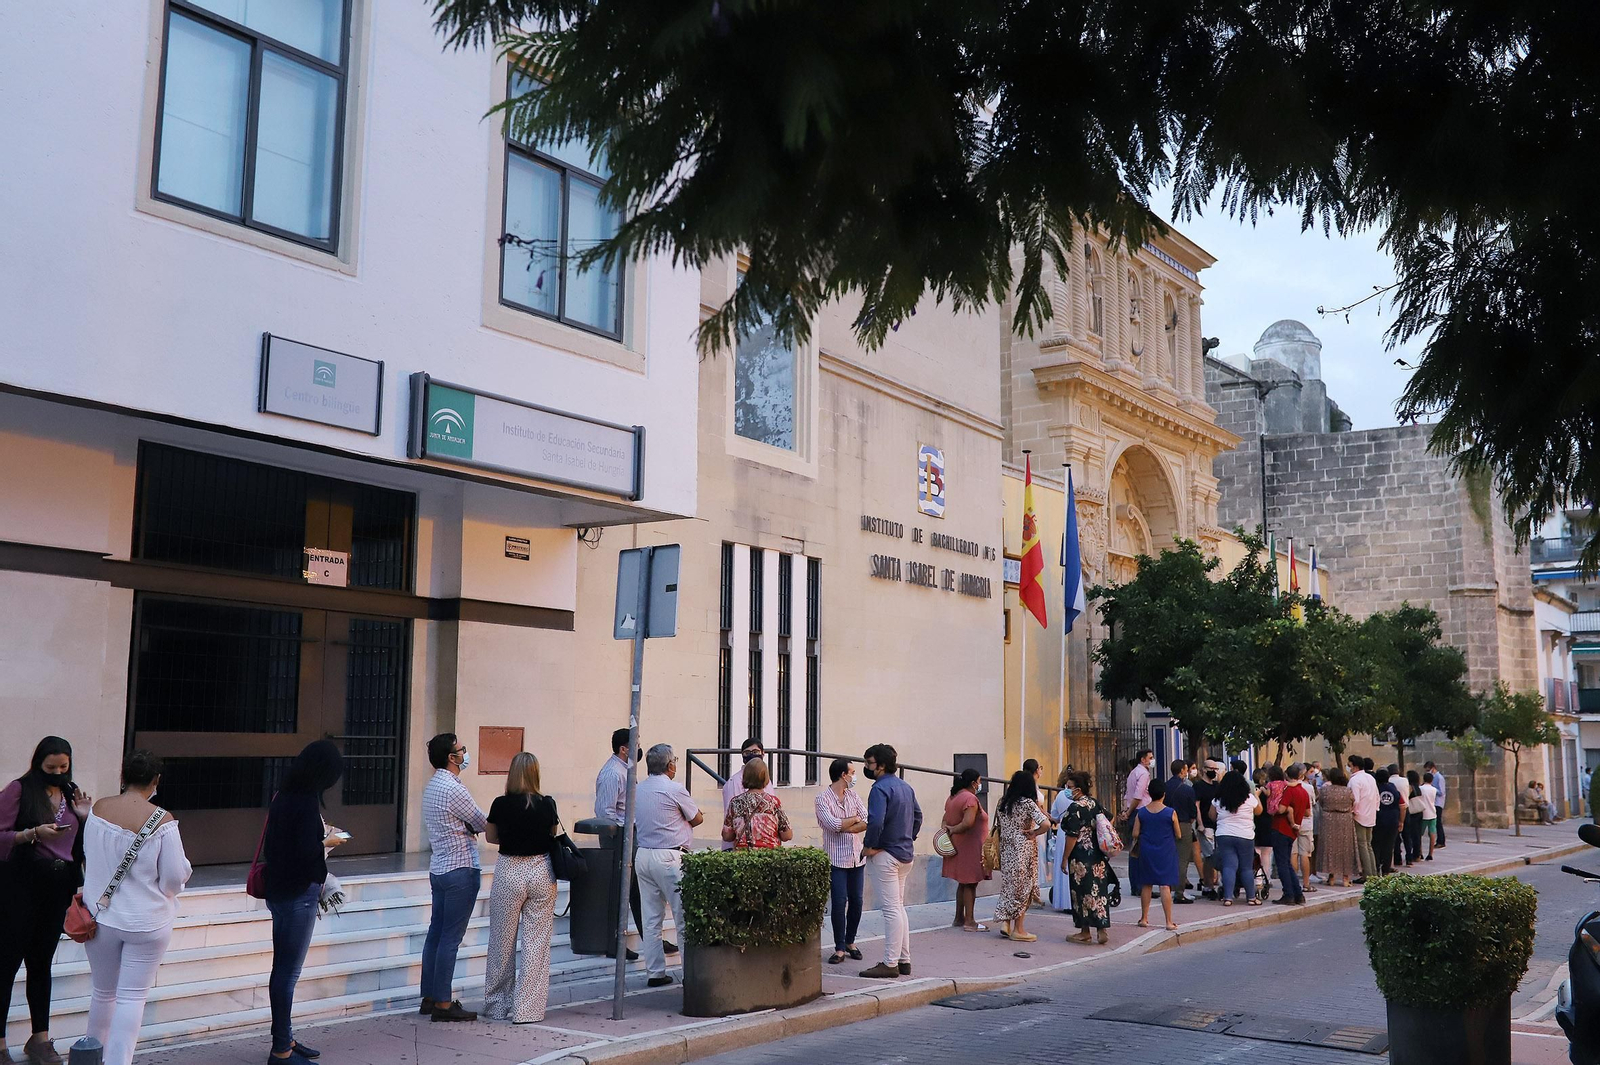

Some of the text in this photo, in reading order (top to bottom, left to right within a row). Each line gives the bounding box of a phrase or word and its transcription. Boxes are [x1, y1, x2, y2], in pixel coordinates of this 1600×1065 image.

[284, 386, 360, 415] Centro bilingüe
[502, 422, 625, 460] Instituto de Educación Secundaria
[542, 449, 563, 464] Santa
[565, 453, 586, 469] Isabel
[588, 458, 597, 471] de
[861, 515, 904, 539] INSTITUTO
[912, 527, 923, 543] DE
[931, 532, 979, 557] BACHILLERATO
[310, 555, 344, 565] ENTRADA
[871, 554, 902, 581] SANTA
[906, 561, 938, 588] ISABEL
[941, 568, 955, 592] DE
[146, 809, 164, 830] BIMBA
